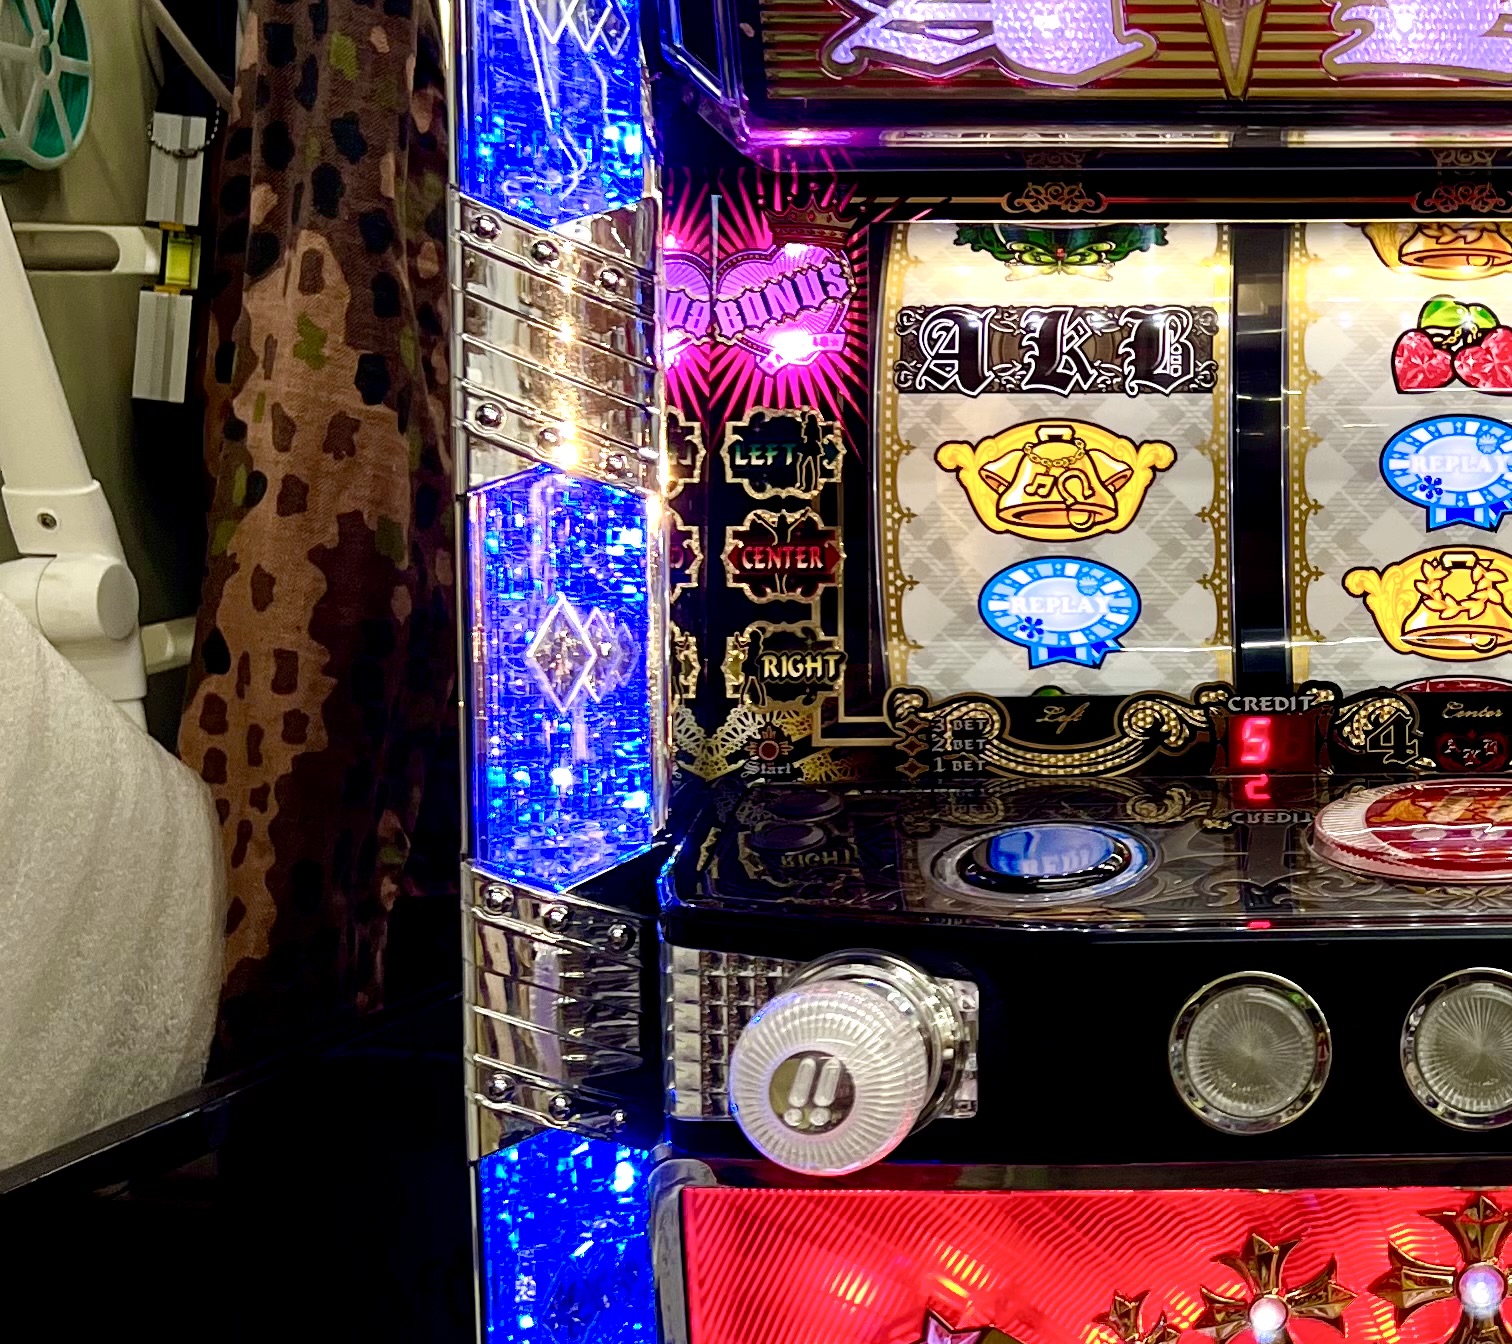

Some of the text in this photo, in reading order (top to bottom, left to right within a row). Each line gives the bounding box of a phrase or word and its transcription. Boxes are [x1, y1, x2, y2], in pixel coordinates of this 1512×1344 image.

[714, 260, 851, 339] BONUS
[915, 305, 1201, 398] AKB
[734, 443, 800, 466] LEFT
[741, 545, 824, 570] CENTER
[1008, 594, 1113, 617] REPLAY
[761, 654, 841, 680] RIGHT
[1228, 696, 1316, 713] CREDIT
[931, 717, 987, 733] 3 BET
[931, 736, 987, 752] 2 BET
[1241, 717, 1271, 764] 5
[744, 758, 794, 776] Start
[935, 757, 987, 773] 1 BET
